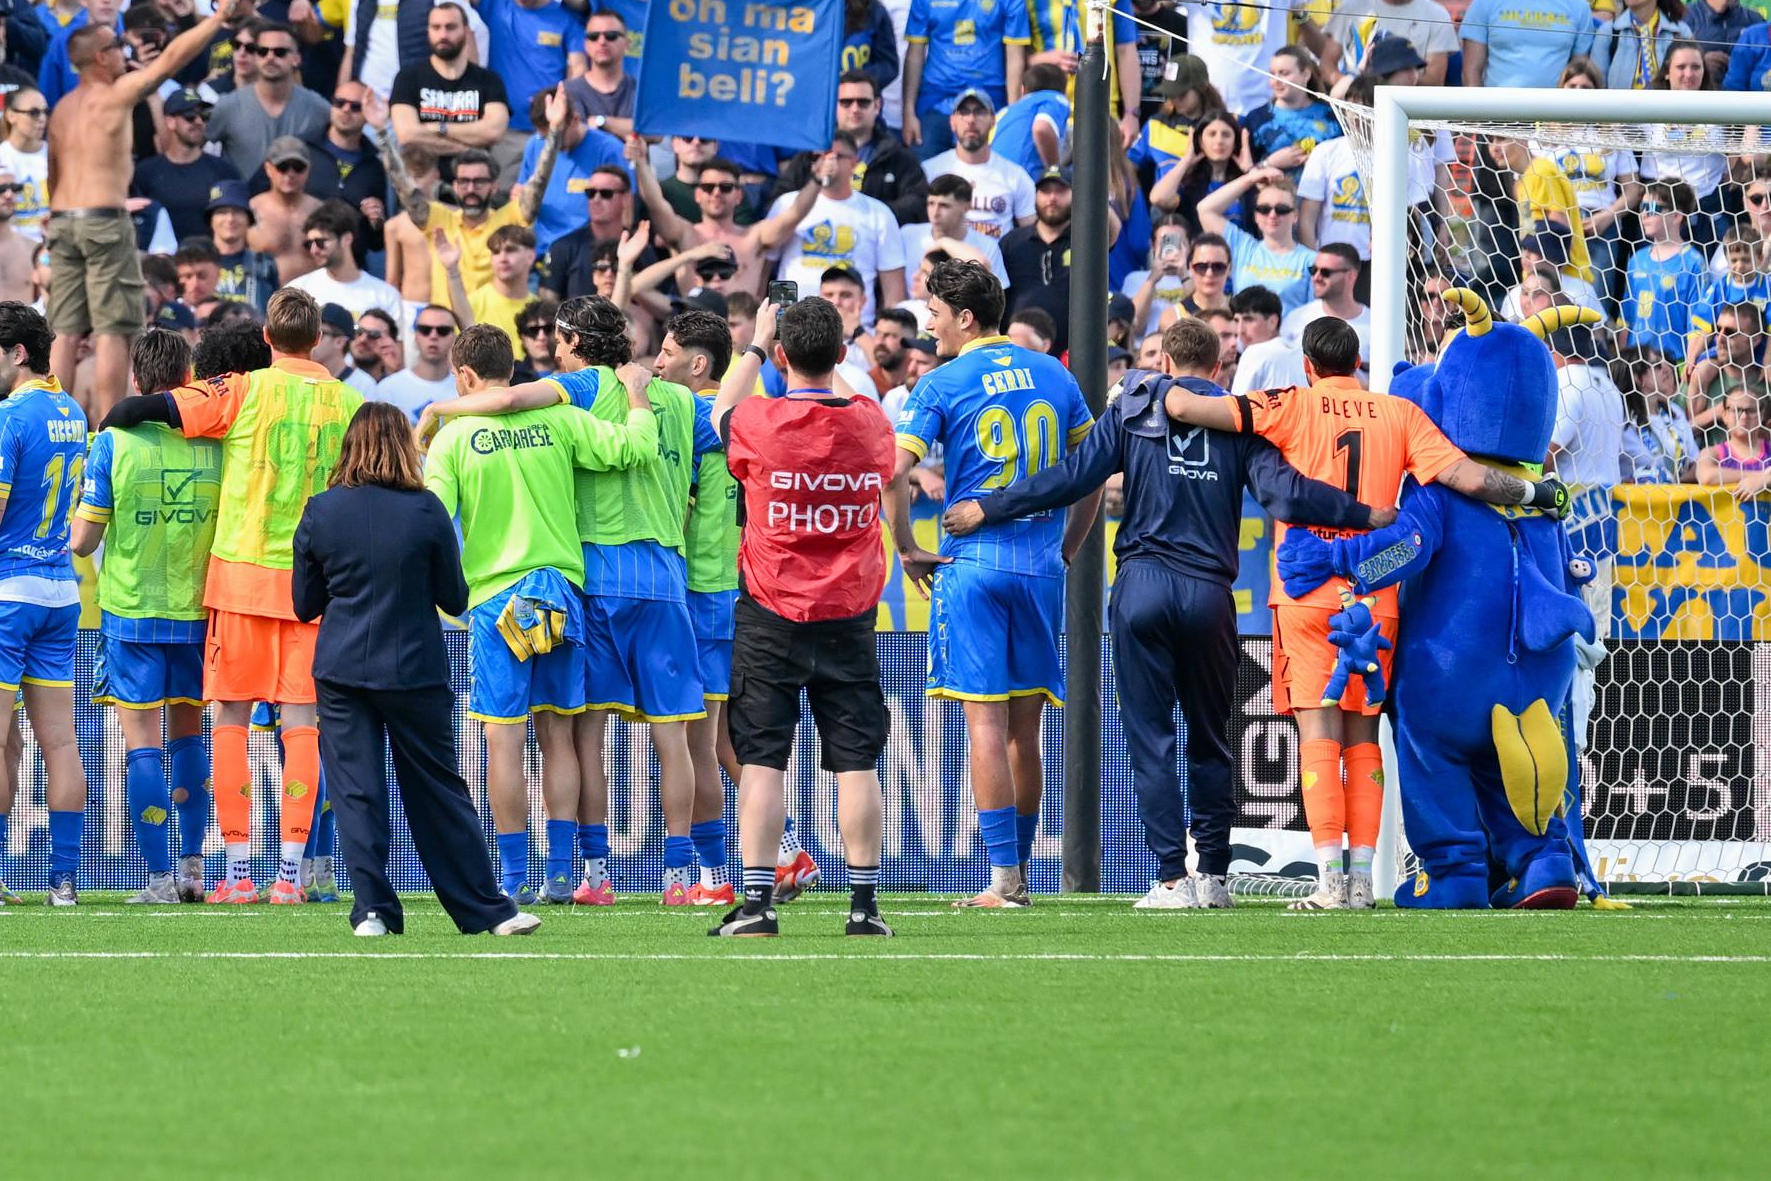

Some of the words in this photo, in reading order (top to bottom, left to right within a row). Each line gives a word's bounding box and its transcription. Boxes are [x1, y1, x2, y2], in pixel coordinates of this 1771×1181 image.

[744, 0, 816, 34] ma
[688, 27, 790, 65] sian
[678, 61, 795, 106] beli?
[982, 368, 1035, 396] CERRI
[1322, 396, 1377, 419] BLEVE
[975, 398, 1059, 494] 90
[1333, 427, 1364, 499] 1
[771, 471, 882, 491] GIVOVA
[768, 500, 875, 534] PHOTO
